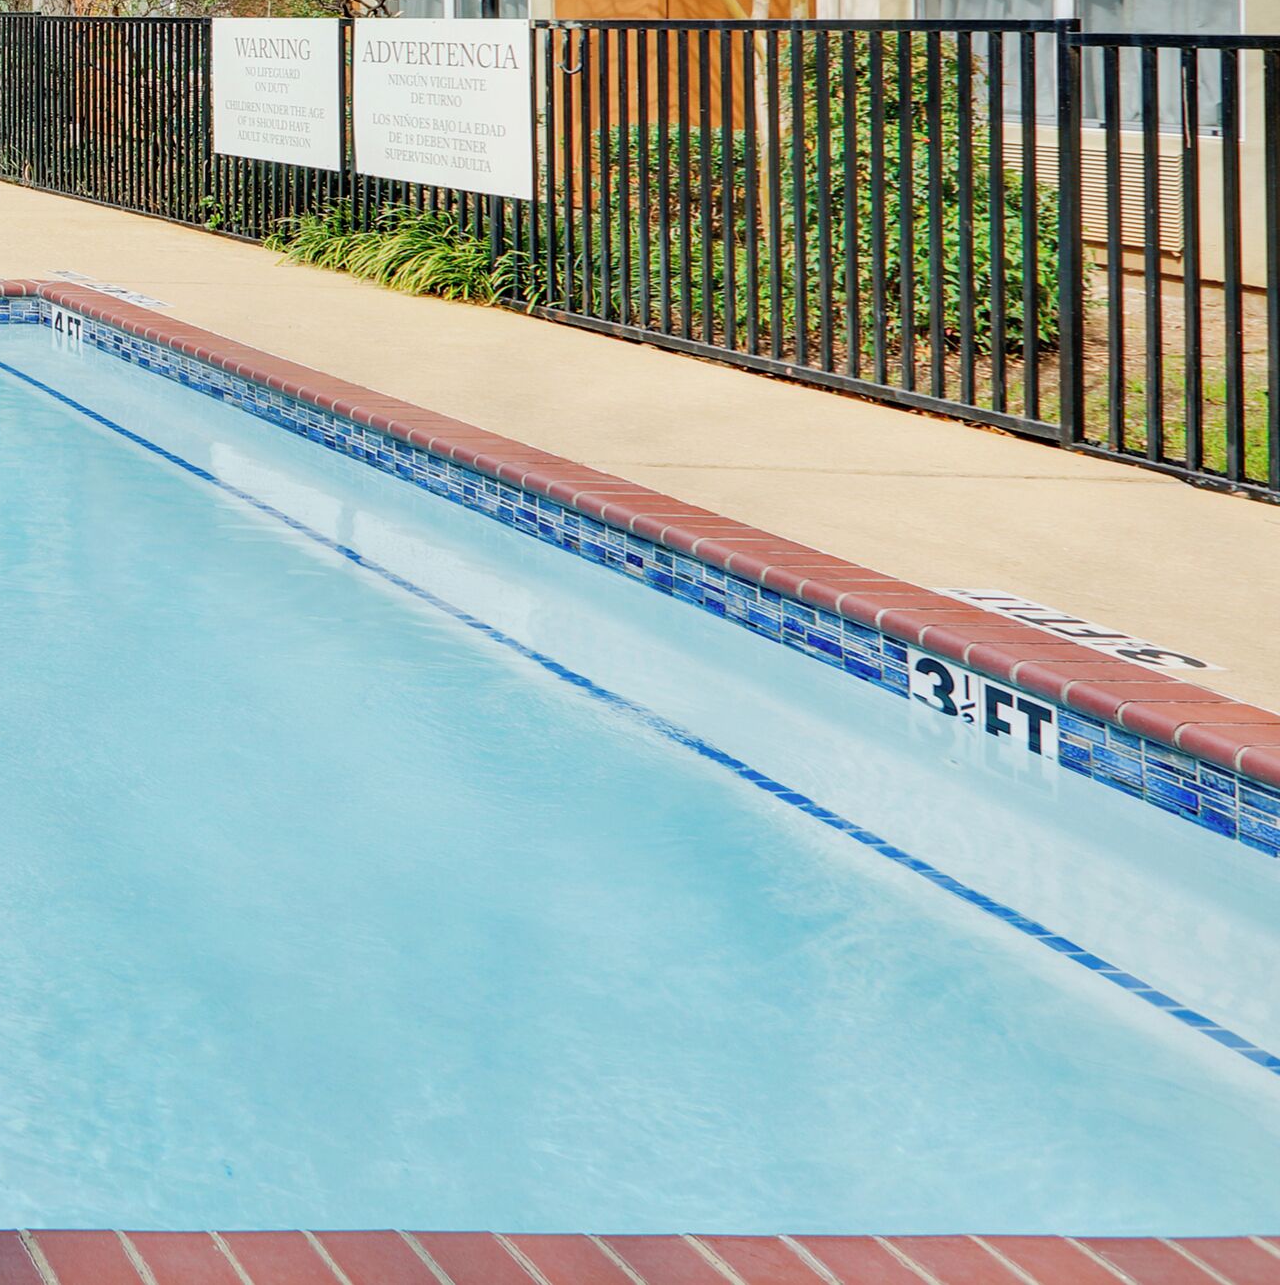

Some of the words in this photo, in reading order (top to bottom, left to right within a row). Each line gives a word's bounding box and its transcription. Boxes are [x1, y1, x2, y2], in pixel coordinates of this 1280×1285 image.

[234, 37, 311, 60] WARNING
[362, 40, 519, 69] ADVERTENCIA
[245, 66, 256, 77] NO
[257, 67, 301, 79] LIFEGUARD
[388, 72, 428, 88] NINGÚN
[429, 76, 487, 91] VIGILANTE
[255, 81, 267, 92] ON
[268, 82, 290, 94] DUTY
[225, 99, 261, 113] CHILDREN
[262, 103, 289, 116] UNDER
[290, 105, 307, 117] THE
[308, 107, 325, 119] AGE
[410, 92, 425, 104] DE
[427, 93, 462, 107] TURNO
[237, 115, 247, 126] OF
[256, 118, 288, 131] SHOULD
[289, 120, 311, 133] HAVE
[372, 113, 391, 125] LOS
[432, 118, 457, 134] BAJO
[458, 121, 472, 134] LA
[474, 122, 506, 137] EDAD
[237, 130, 260, 143] ADULT
[261, 133, 311, 148] SUPERVISION
[388, 131, 403, 144] DE
[405, 134, 415, 145] 18
[416, 134, 451, 149] DEBEN
[451, 138, 487, 154] TENER
[385, 147, 449, 167] SUPERVISION
[450, 156, 492, 173] ADULTA
[55, 311, 64, 332] 4
[68, 315, 81, 340] FT
[985, 684, 1053, 755] FT
